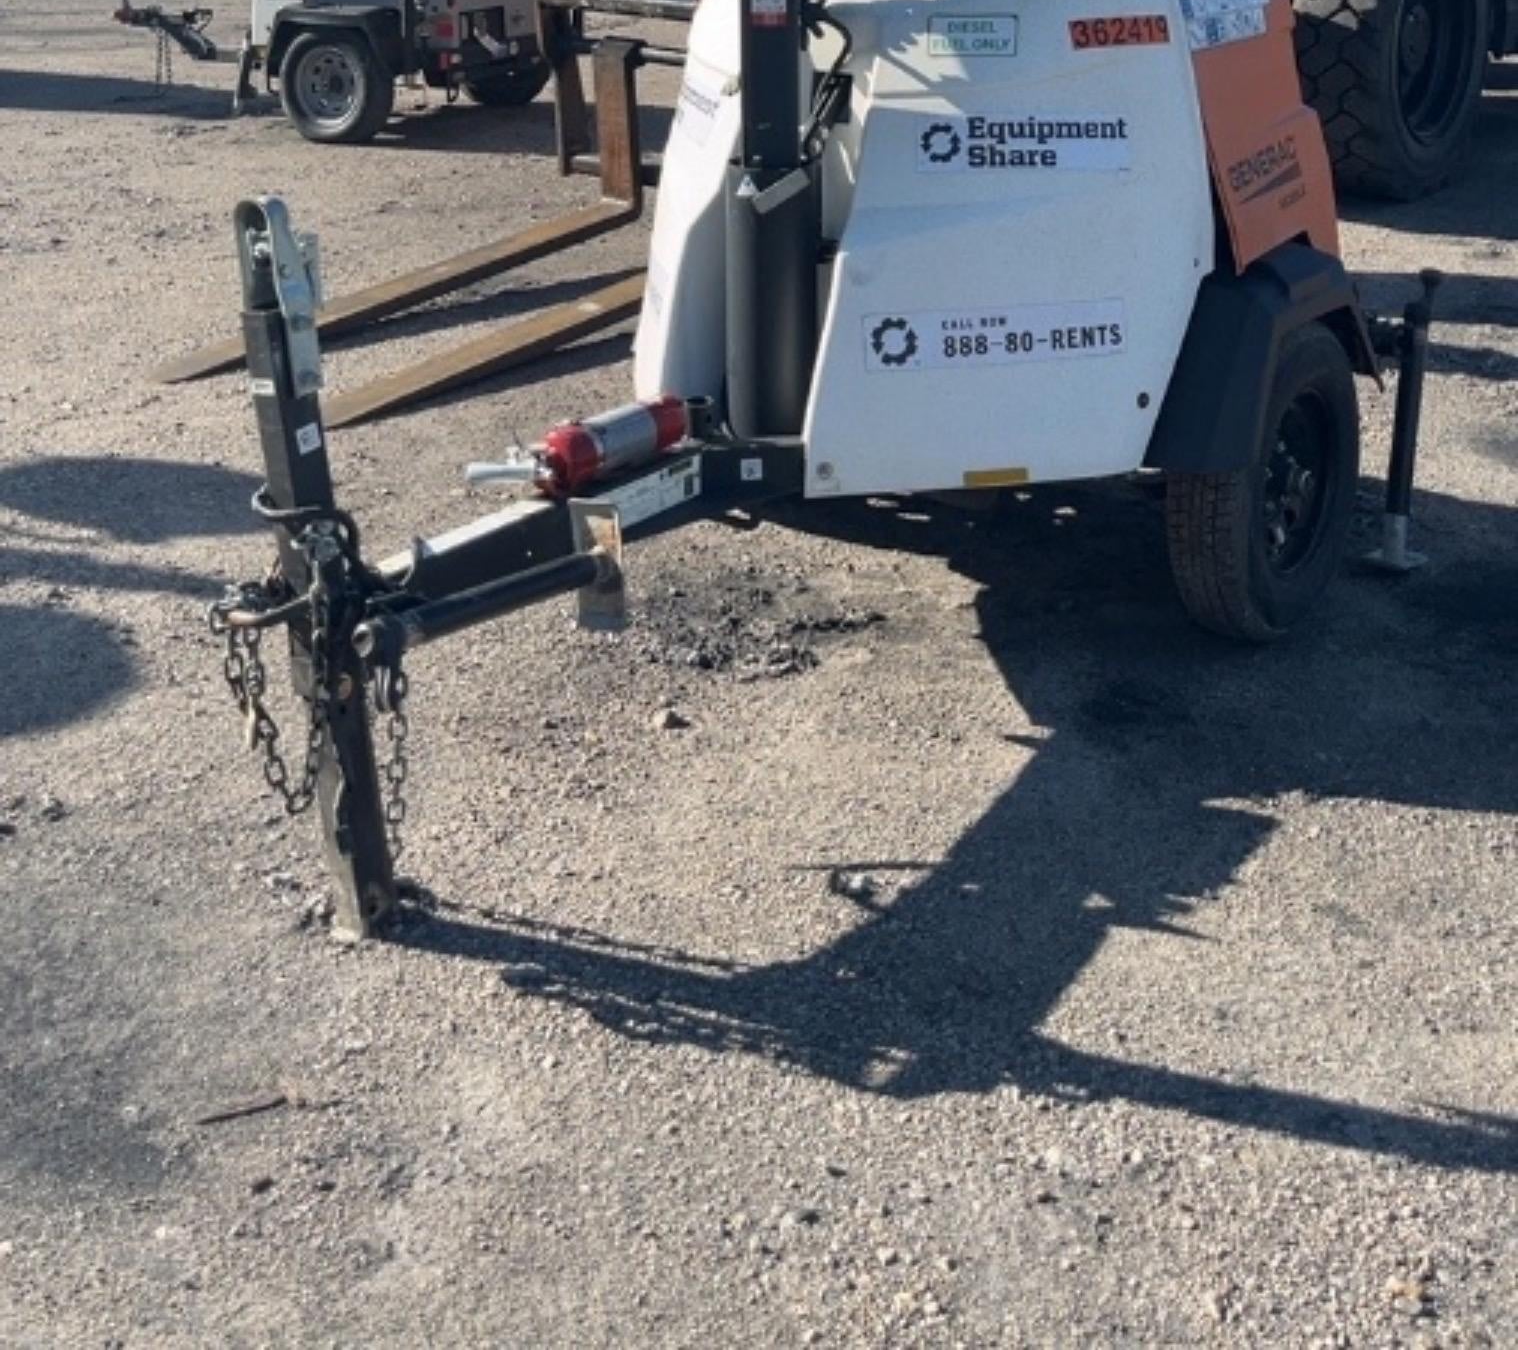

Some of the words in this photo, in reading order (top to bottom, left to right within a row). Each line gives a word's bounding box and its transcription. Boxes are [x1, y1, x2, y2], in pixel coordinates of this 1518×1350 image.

[947, 20, 996, 34] DIESEL
[1071, 15, 1169, 48] 362419
[932, 38, 967, 51] FUEL
[971, 38, 1011, 51] ONLY
[966, 116, 1128, 144] Equipment
[967, 144, 1057, 168] Share
[1227, 135, 1297, 191] GENERAC
[941, 319, 974, 331] CALL
[980, 317, 1007, 328] NOW
[943, 323, 1122, 358] 888-80-RENTS
